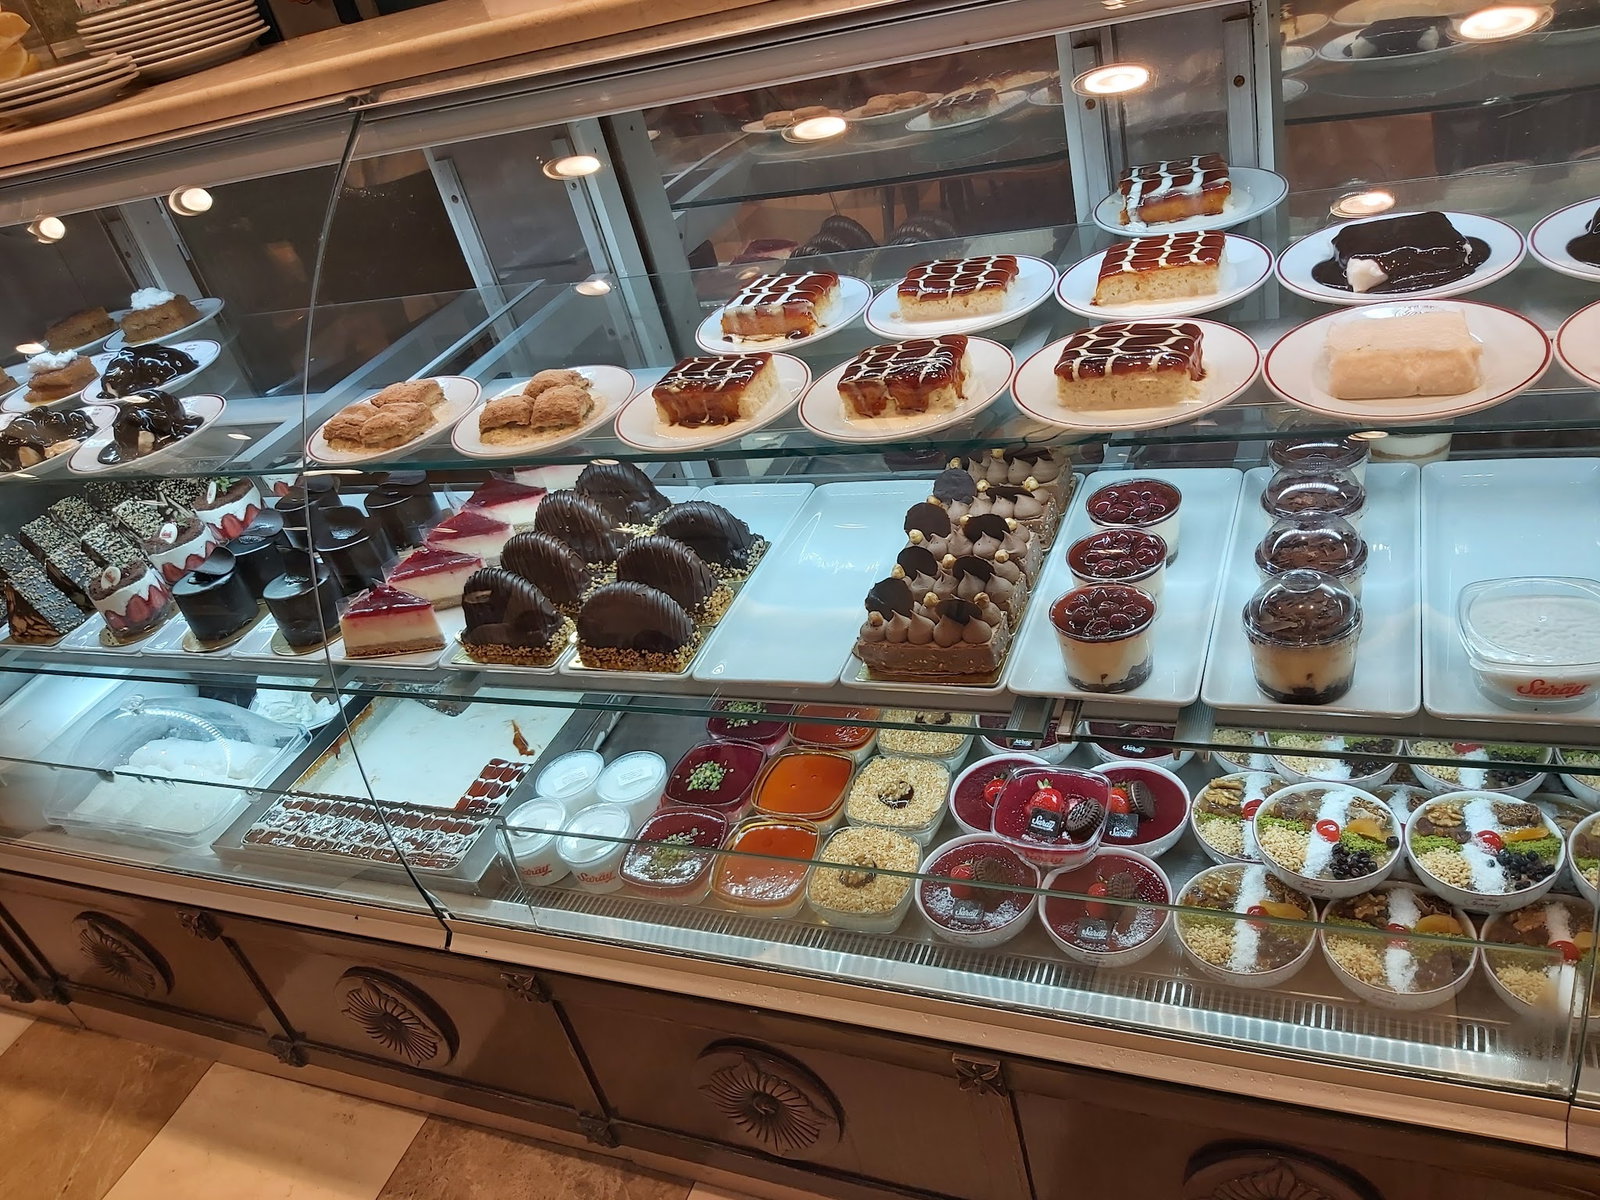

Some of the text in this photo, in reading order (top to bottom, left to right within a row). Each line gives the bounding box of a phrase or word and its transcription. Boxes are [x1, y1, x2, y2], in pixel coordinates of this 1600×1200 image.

[1517, 679, 1591, 698] Saray
[1031, 815, 1056, 829] Saray
[1109, 827, 1134, 838] Saray
[577, 870, 617, 883] Saray
[955, 907, 979, 917] Saray
[1081, 926, 1108, 937] Saray
